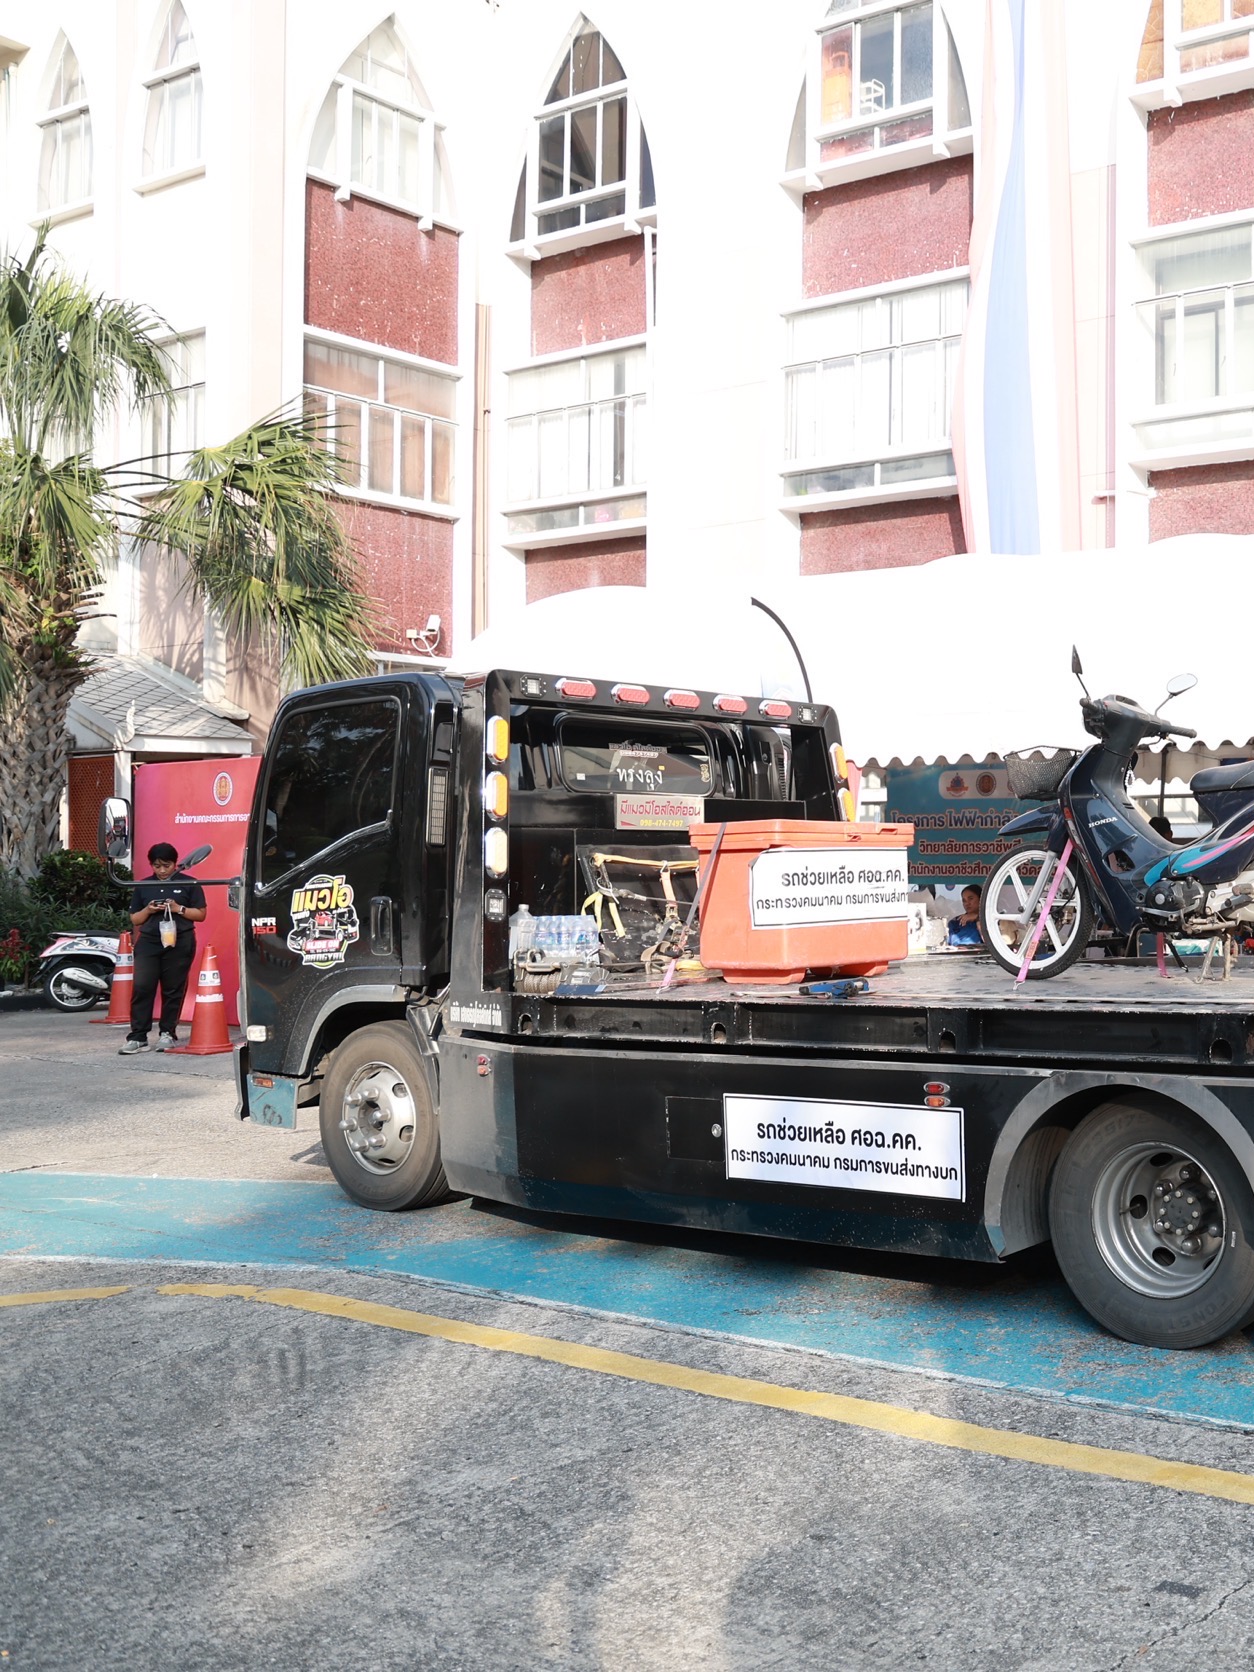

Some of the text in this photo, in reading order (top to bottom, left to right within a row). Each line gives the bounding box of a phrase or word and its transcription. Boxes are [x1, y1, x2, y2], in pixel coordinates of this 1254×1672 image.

[947, 807, 1018, 828] ไฟฟ้ากำลั
[1088, 816, 1118, 829] HONDA
[782, 865, 854, 887] รถช่วยเหลือ
[292, 876, 352, 913] แมวโอ
[756, 894, 843, 910] กระทรวงคมนาคม
[251, 917, 277, 926] NPR
[252, 926, 277, 935] 150
[757, 1117, 922, 1151] รถช่วยเหลือ ศอฉ.คค.
[731, 1147, 958, 1181] กระทรวงคมนาคม กรมการขนส่งทางบก
